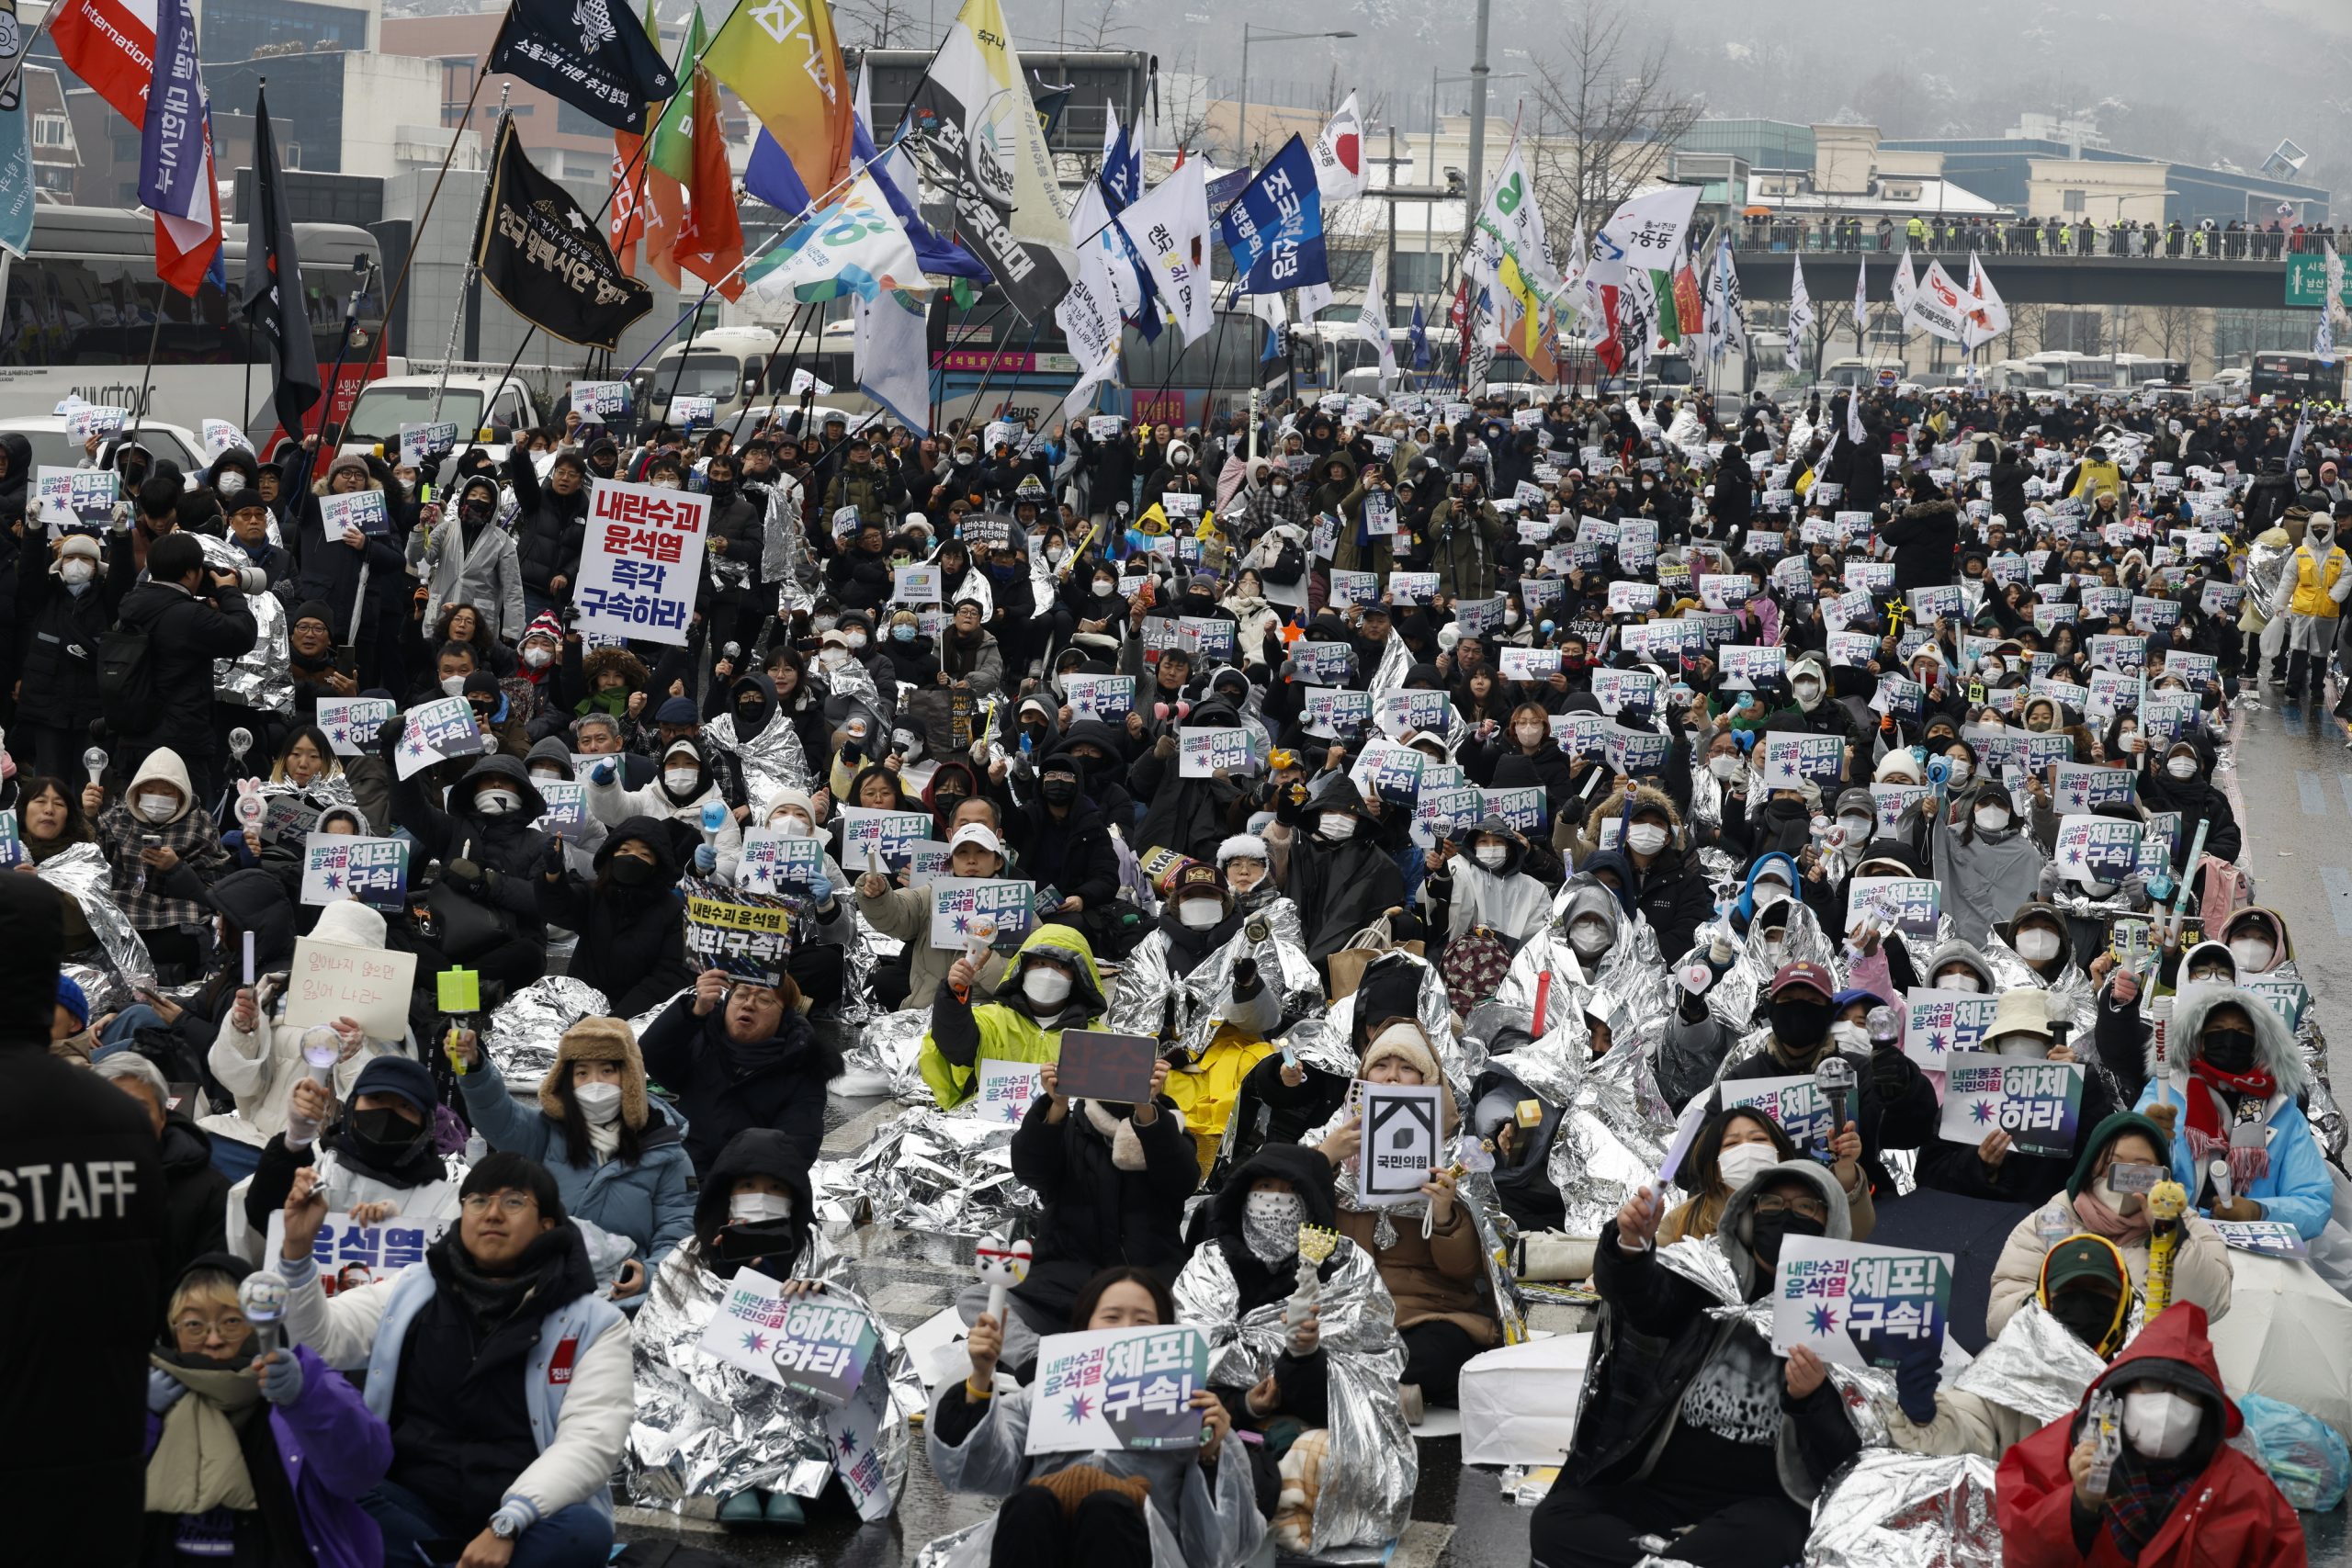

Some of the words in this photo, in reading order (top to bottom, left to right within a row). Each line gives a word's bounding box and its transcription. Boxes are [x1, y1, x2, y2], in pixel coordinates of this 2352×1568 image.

[561, 62, 588, 83] 귀환
[584, 77, 611, 98] 추진
[608, 87, 630, 107] 협회
[1262, 167, 1305, 280] 조국혁신당
[499, 204, 528, 249] 전국
[526, 230, 596, 293] 밀레시안
[595, 382, 624, 400] 해체
[91, 409, 121, 420] 체포!
[595, 398, 624, 415] 하라
[426, 423, 455, 442] 체포!
[72, 472, 114, 493] 체포!
[72, 491, 114, 512] 구속!
[348, 491, 379, 512] 체포!
[326, 505, 349, 520] 윤석열
[352, 508, 383, 526] 구속!
[595, 490, 702, 534] 내란수괴
[603, 525, 684, 564] 윤석열
[1572, 543, 1597, 557] 체포!
[1575, 555, 1598, 566] 구속!
[1866, 564, 1892, 577] 체포!
[611, 558, 667, 594] 즉각
[1866, 574, 1892, 588] 구속!
[1932, 586, 1959, 602] 체포!
[581, 587, 686, 630] 구속하라
[1931, 599, 1960, 616] 구속!
[2114, 637, 2144, 652] 체포!
[1747, 648, 1783, 664] 체포!
[2115, 650, 2143, 664] 구속!
[1747, 663, 1781, 680] 구속!
[1070, 682, 1095, 691] 내란수괴
[1094, 677, 1131, 695] 체포!
[1619, 674, 1655, 692] 체포!
[1069, 689, 1095, 699] 윤석열
[1332, 691, 1369, 712] 체포!
[1410, 694, 1443, 712] 해체
[1619, 691, 1652, 707] 구속!
[320, 705, 349, 717] 내란동조
[349, 702, 388, 722] 해체
[420, 697, 467, 729] 체포!
[1095, 695, 1130, 714] 구속!
[321, 715, 349, 727] 국민의힘
[1211, 729, 1248, 751] 해체
[1625, 735, 1667, 754] 체포!
[1799, 739, 1839, 760] 체포!
[1211, 750, 1248, 769] 하라
[1382, 749, 1422, 773] 체포!
[1624, 752, 1661, 772] 구속!
[1800, 758, 1838, 778] 구속!
[1376, 770, 1415, 794] 구속!
[849, 818, 880, 830] 내란수괴
[880, 815, 925, 839] 체포!
[2087, 822, 2138, 845] 체포!
[311, 842, 349, 861] 내란수괴
[347, 840, 401, 868] 체포!
[2086, 845, 2132, 867] 구속!
[311, 854, 347, 872] 윤석열
[346, 867, 400, 893] 구속!
[938, 898, 974, 914] 윤석열
[975, 884, 1026, 910] 체포!
[693, 901, 736, 924] 내란수괴
[737, 911, 782, 930] 윤석열
[309, 952, 354, 973] 일어나지
[1912, 1004, 1954, 1018] 내란수괴
[1912, 1014, 1954, 1030] 윤석열
[2154, 1020, 2165, 1062] TWINS
[985, 1075, 1031, 1089] 내란수괴
[1951, 1066, 2001, 1081] 내란동조
[2002, 1064, 2071, 1100] 해체
[985, 1084, 1029, 1102] 윤석열
[1951, 1077, 2002, 1093] 국민의힘
[1999, 1100, 2065, 1132] 하라
[1377, 1154, 1428, 1171] 국민의힘
[0, 1160, 138, 1230] STAFF
[1785, 1258, 1850, 1280] 내란수괴
[1849, 1254, 1939, 1301] 체포!
[1784, 1275, 1848, 1301] 윤석열
[733, 1288, 788, 1315] 내란동조
[728, 1301, 786, 1329] 국민의힘
[788, 1302, 865, 1348] 해체
[1847, 1300, 1934, 1341] 구속!
[772, 1337, 852, 1382] 하라
[1046, 1345, 1105, 1379] 내란수괴
[1105, 1330, 1194, 1382] 체포!
[1043, 1365, 1105, 1399] 윤석열
[1102, 1374, 1193, 1423] 구속!
